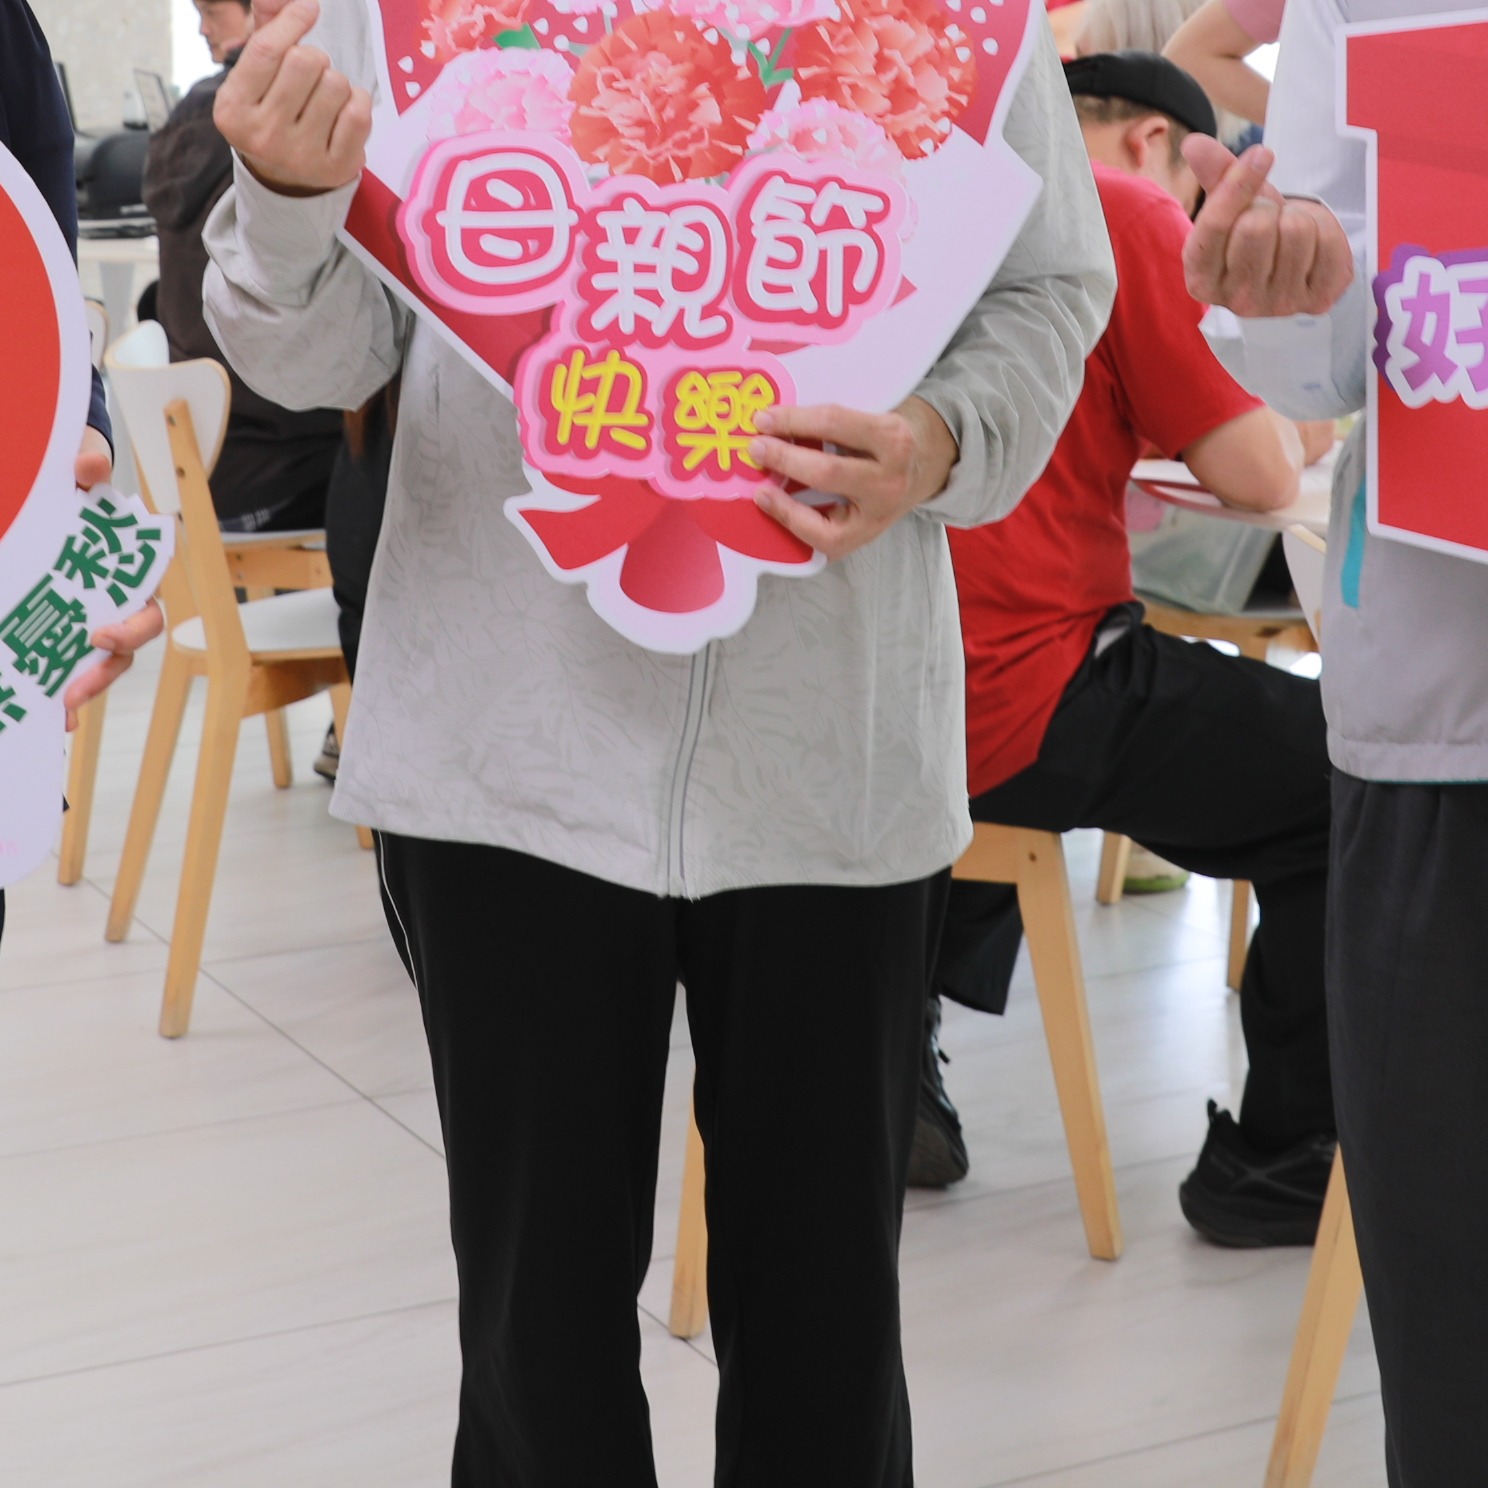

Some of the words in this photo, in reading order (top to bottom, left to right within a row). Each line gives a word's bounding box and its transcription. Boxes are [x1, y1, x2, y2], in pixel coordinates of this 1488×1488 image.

[435, 152, 890, 340] 母親節
[550, 348, 780, 472] 快樂
